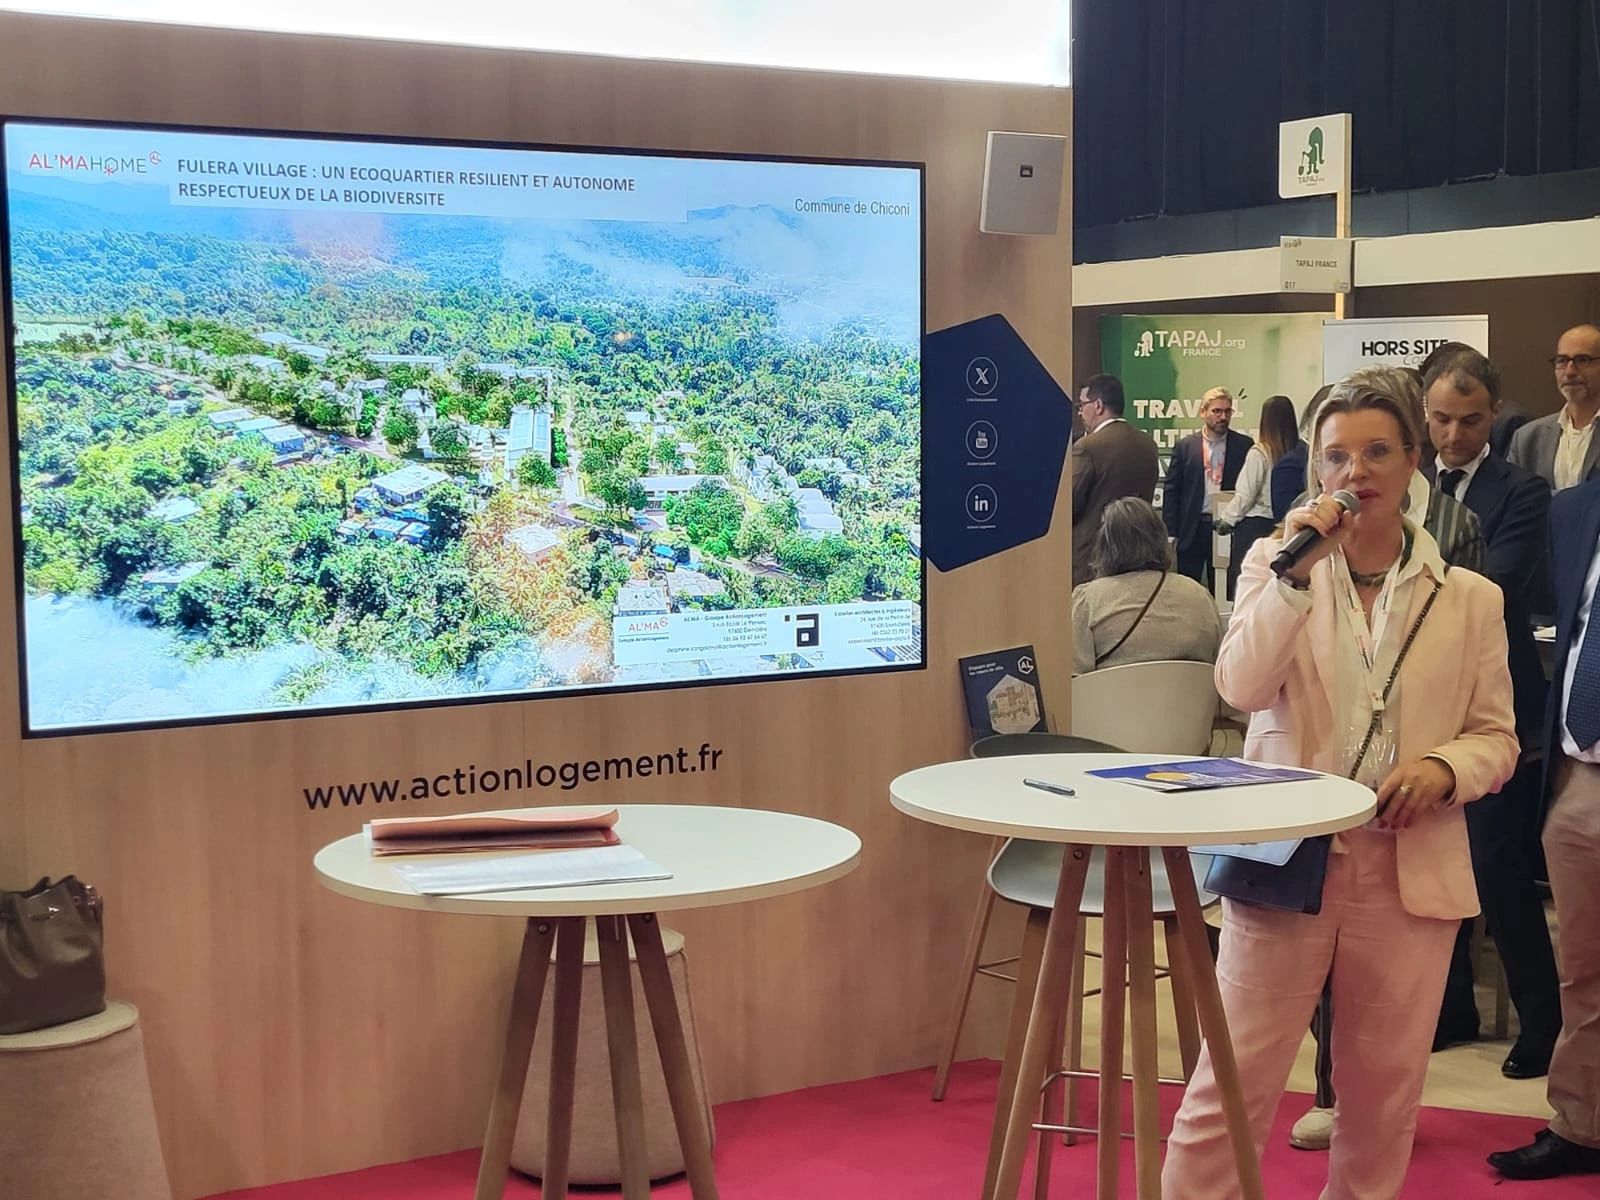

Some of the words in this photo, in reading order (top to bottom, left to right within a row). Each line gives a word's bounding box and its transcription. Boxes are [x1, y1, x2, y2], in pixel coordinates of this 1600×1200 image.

[177, 158, 239, 175] FULERA
[243, 161, 308, 178] VILLAGE
[321, 165, 345, 179] UN
[350, 166, 455, 185] ECOQUARTIER
[459, 171, 529, 188] RESILIENT
[533, 174, 550, 188] ET
[553, 175, 636, 192] AUTONOME
[178, 182, 291, 200] RESPECTUEUX
[295, 187, 315, 201] DE
[320, 188, 339, 203] LA
[343, 189, 446, 206] BIODIVERSITE
[794, 198, 851, 214] Commune
[853, 200, 868, 214] de
[870, 200, 911, 216] Chiconi
[1315, 260, 1337, 269] FRANCE
[1154, 329, 1246, 350] TAPAJ.org
[1361, 340, 1410, 356] HORS
[1413, 339, 1449, 355] SIT
[1183, 347, 1222, 357] FRANCE
[1133, 399, 1244, 419] TRAVL
[974, 494, 989, 512] in
[628, 621, 660, 633] AL'MA
[303, 743, 723, 811] www.actionlogement.fr
